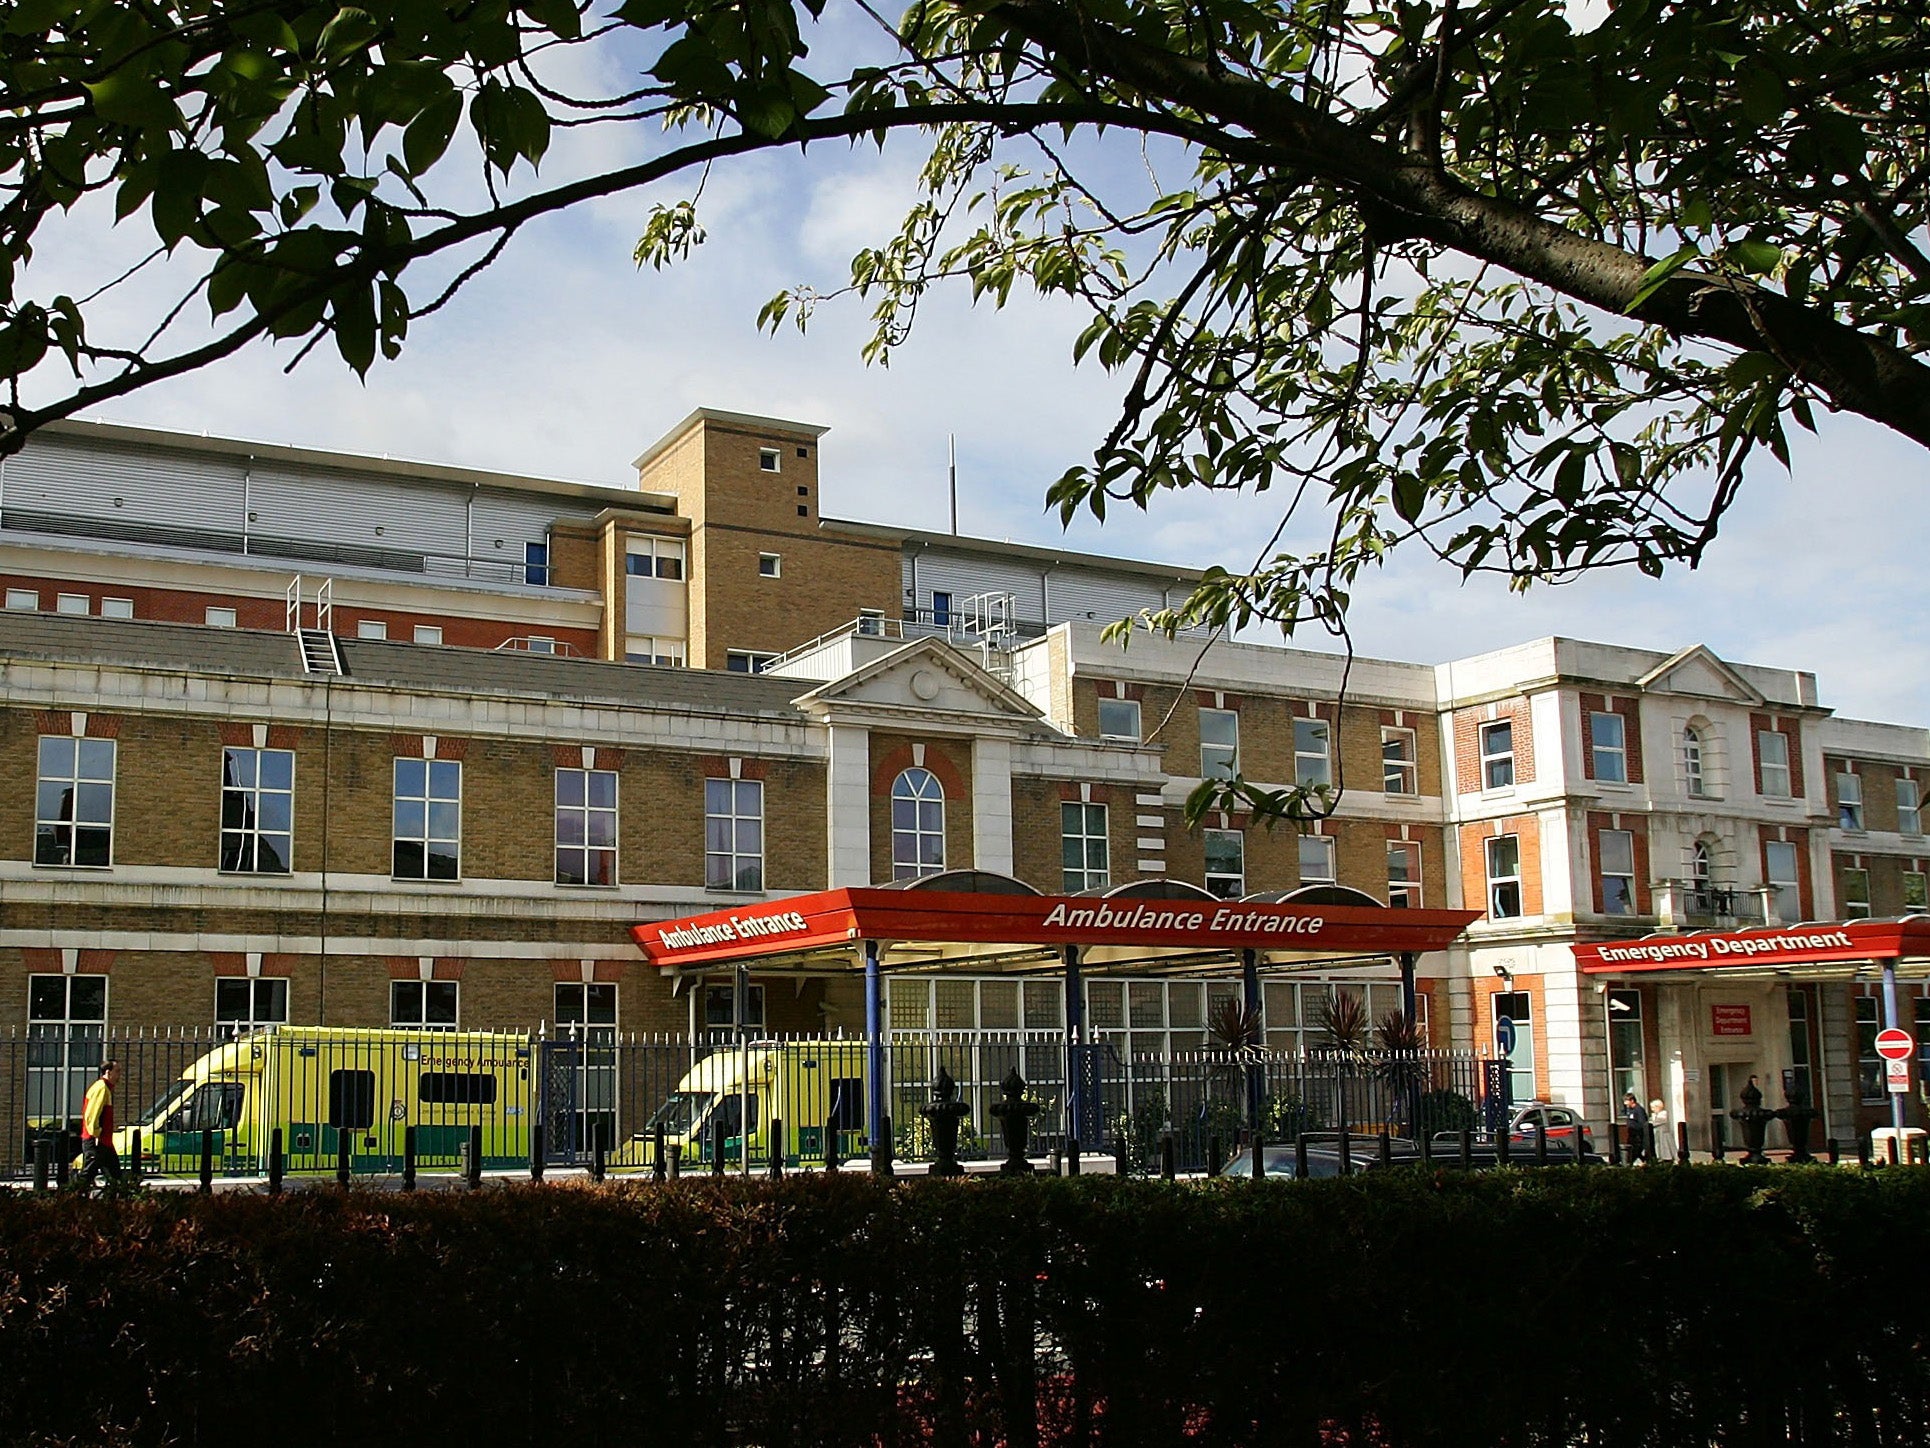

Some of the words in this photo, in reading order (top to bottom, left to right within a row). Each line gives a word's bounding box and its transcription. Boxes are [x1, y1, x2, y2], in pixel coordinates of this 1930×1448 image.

[658, 922, 737, 950] Ambulance
[729, 911, 808, 939] Entrance
[1042, 903, 1204, 931] Ambulance
[1209, 908, 1325, 934] Entrance
[1597, 940, 1708, 963] Emergency
[1710, 931, 1852, 956] Department
[421, 1055, 475, 1068] Emegency
[477, 1056, 530, 1068] Ambuance
